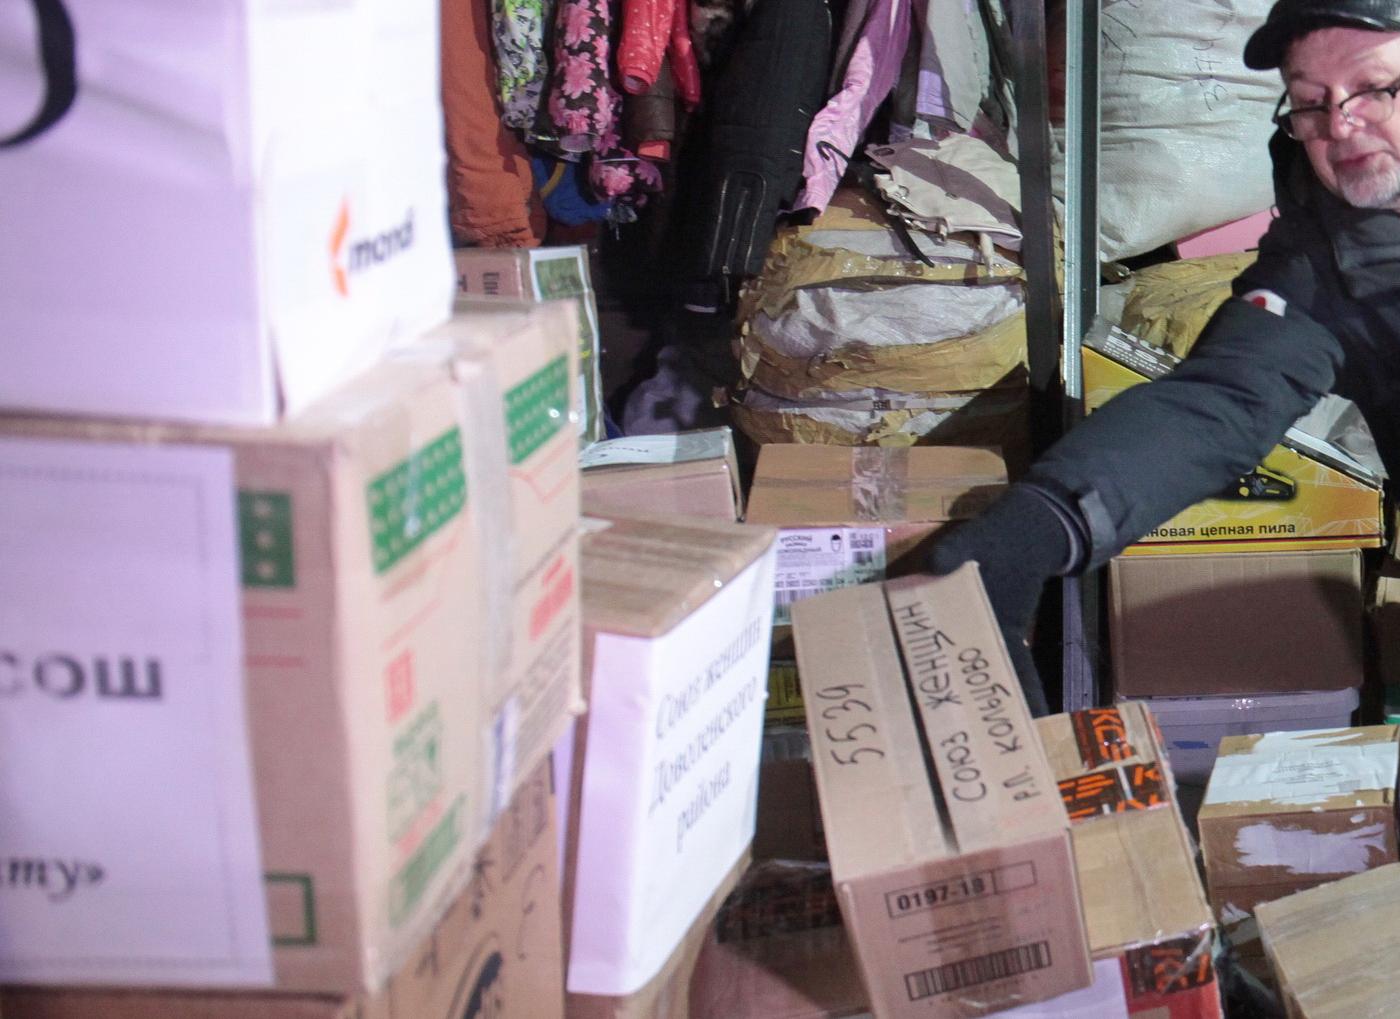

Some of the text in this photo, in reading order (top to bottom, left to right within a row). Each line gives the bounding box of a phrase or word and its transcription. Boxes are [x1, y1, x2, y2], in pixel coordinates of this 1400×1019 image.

[1146, 523, 1296, 537] новая цепная пила
[816, 684, 885, 765] 5539
[895, 601, 987, 802] СОЮЗ ЖЕНЩИН
